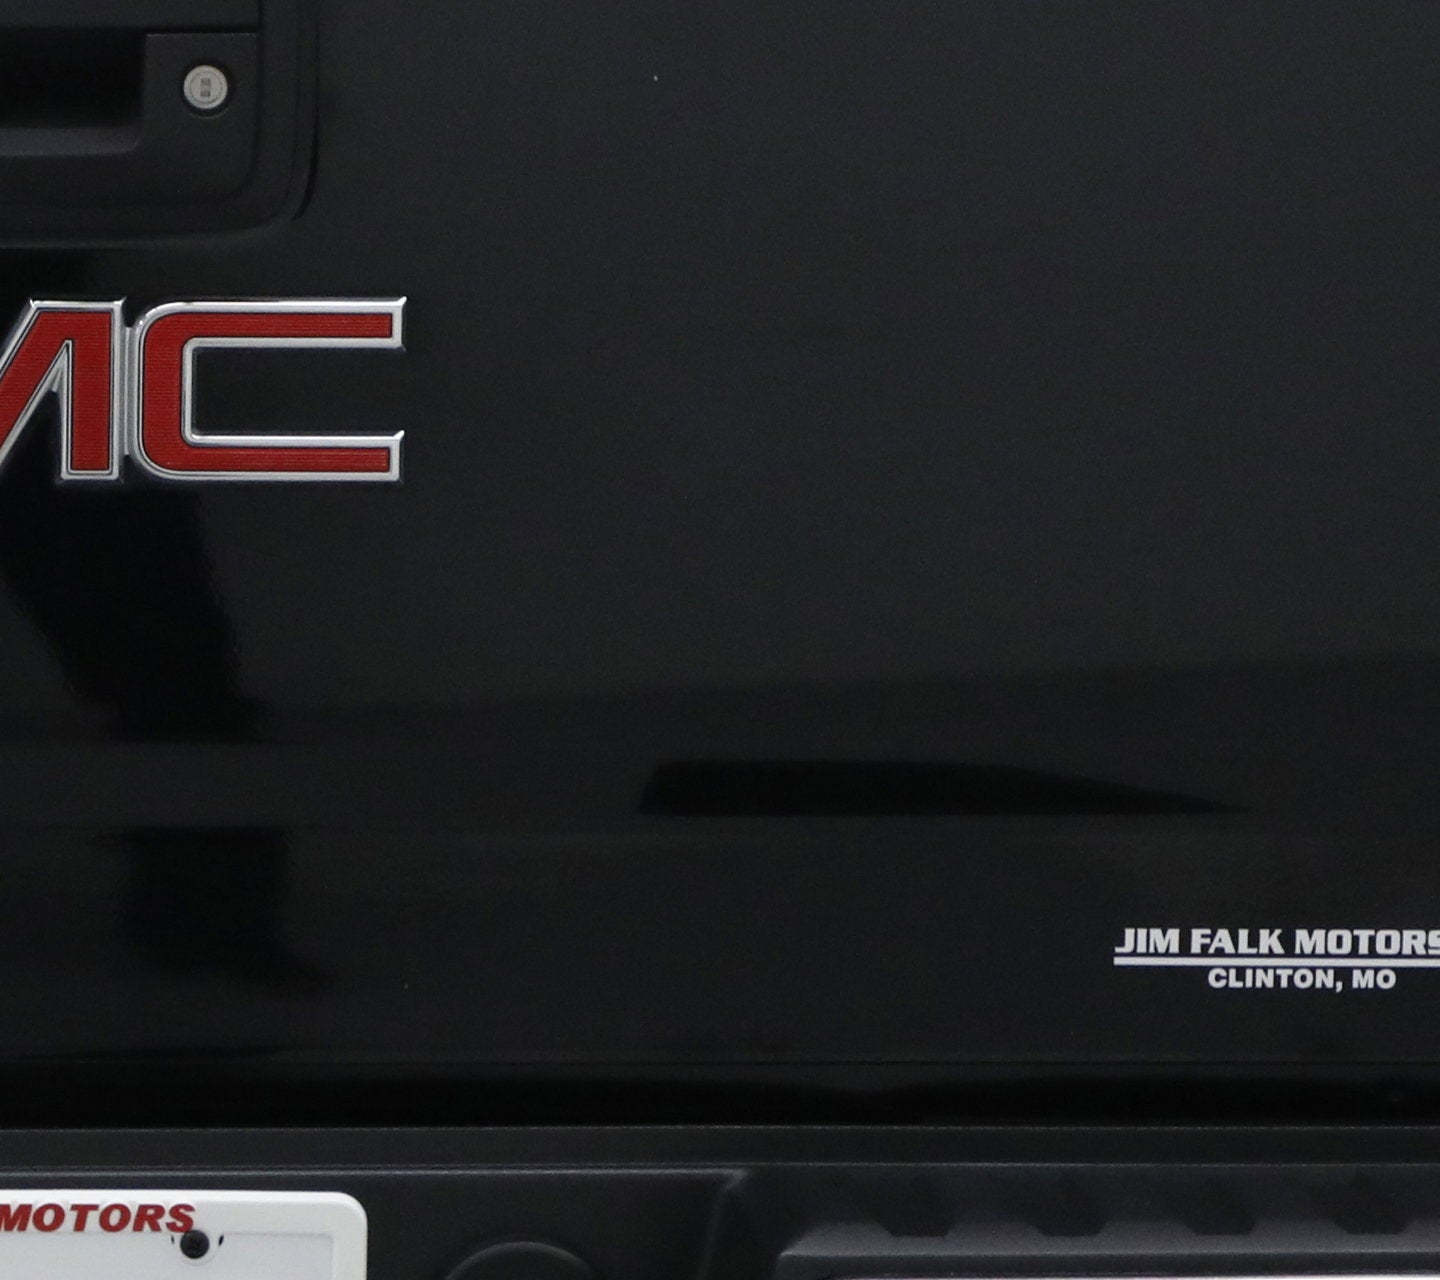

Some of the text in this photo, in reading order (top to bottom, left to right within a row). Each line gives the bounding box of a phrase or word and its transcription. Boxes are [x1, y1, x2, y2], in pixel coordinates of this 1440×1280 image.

[1115, 928, 1180, 955] JIM
[1190, 928, 1286, 955] FALK
[1208, 968, 1397, 992] CLINTON, MO
